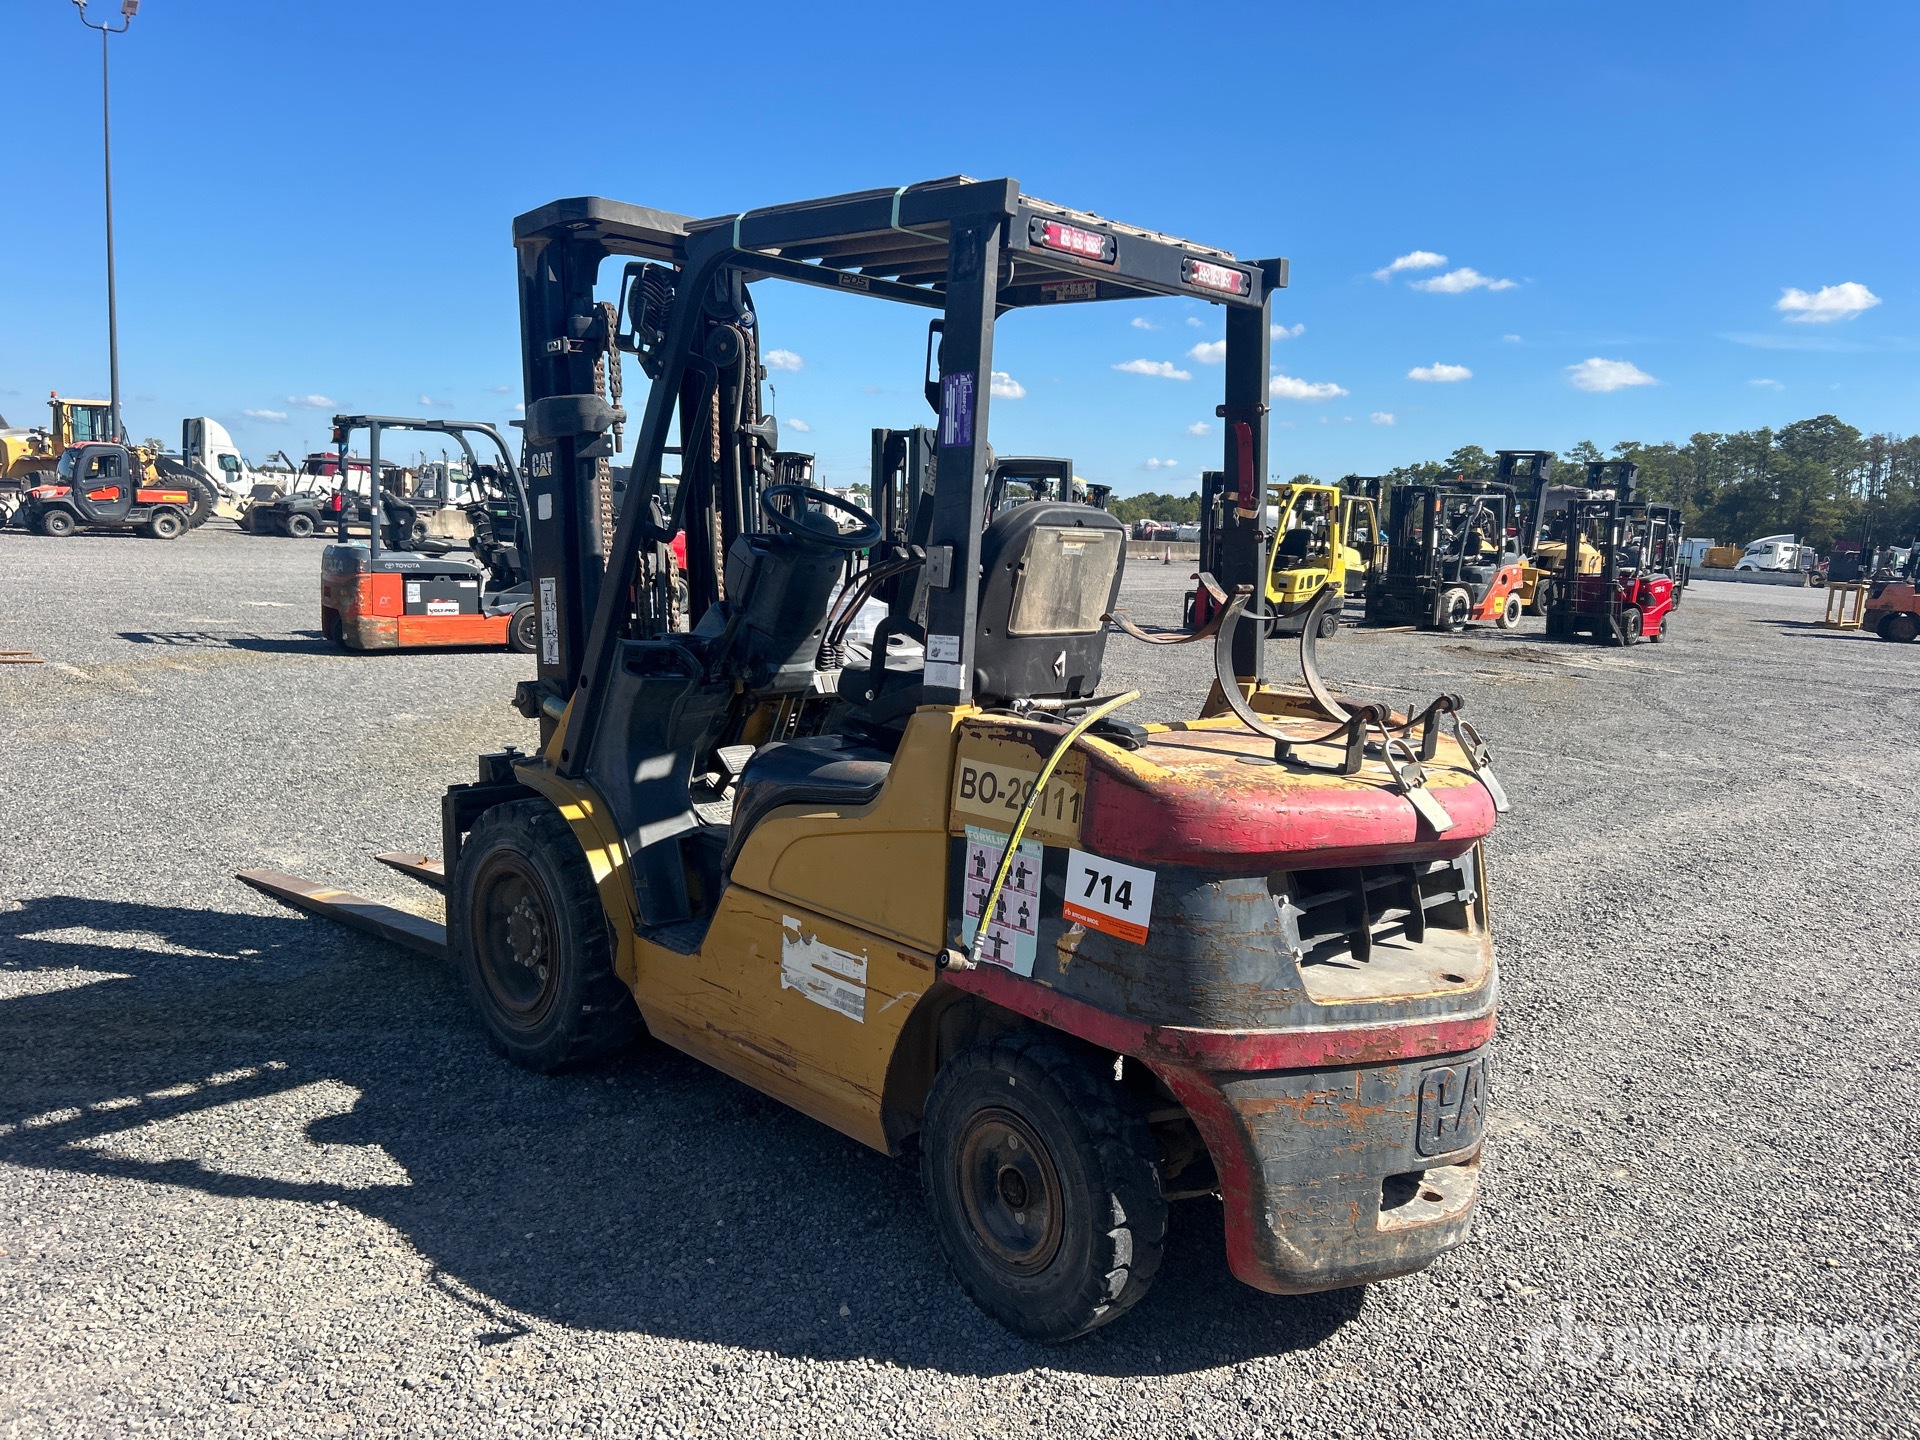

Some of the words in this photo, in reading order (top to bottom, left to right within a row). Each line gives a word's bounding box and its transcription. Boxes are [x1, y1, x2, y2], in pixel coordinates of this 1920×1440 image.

[531, 451, 553, 478] CAT
[967, 831, 1009, 847] FORKLIF
[1084, 868, 1133, 910] 714
